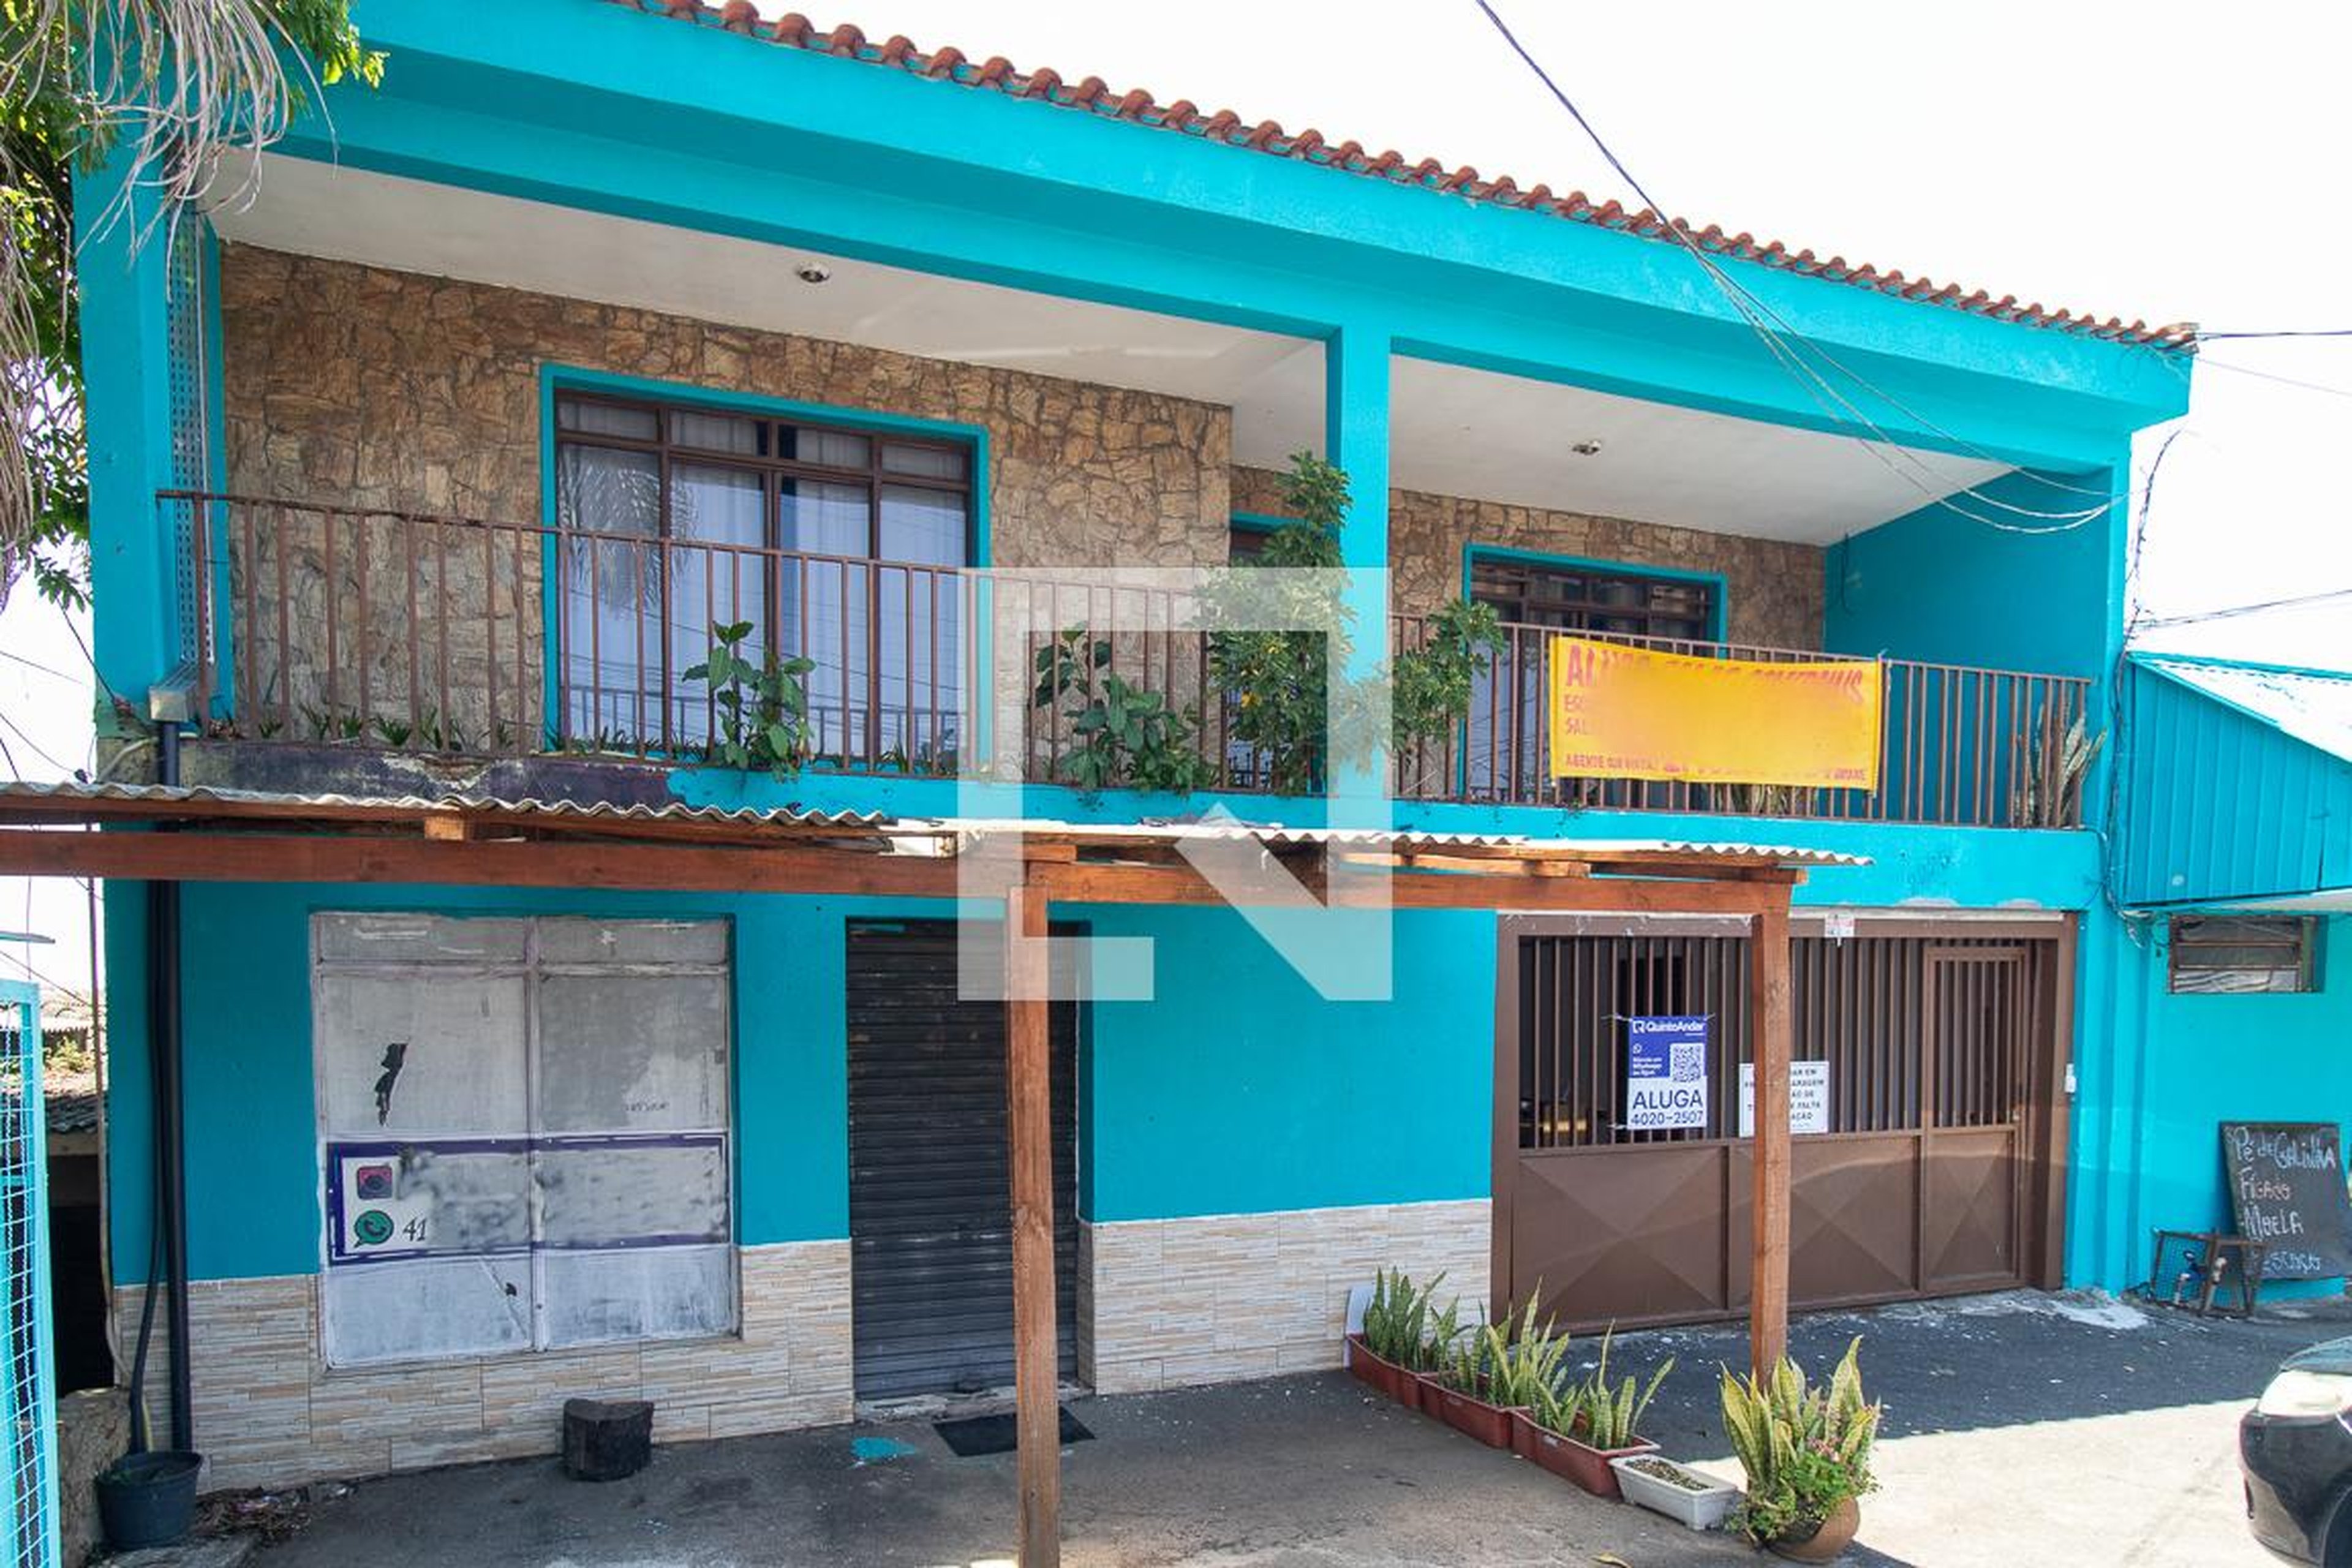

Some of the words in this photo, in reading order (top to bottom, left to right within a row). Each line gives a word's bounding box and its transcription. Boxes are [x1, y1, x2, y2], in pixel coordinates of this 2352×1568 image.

[1646, 1020, 1704, 1031] QuintoAndar
[1632, 1089, 1703, 1109] ALUGA
[1630, 1110, 1703, 1126] 4020-2507
[402, 1217, 428, 1242] 41
